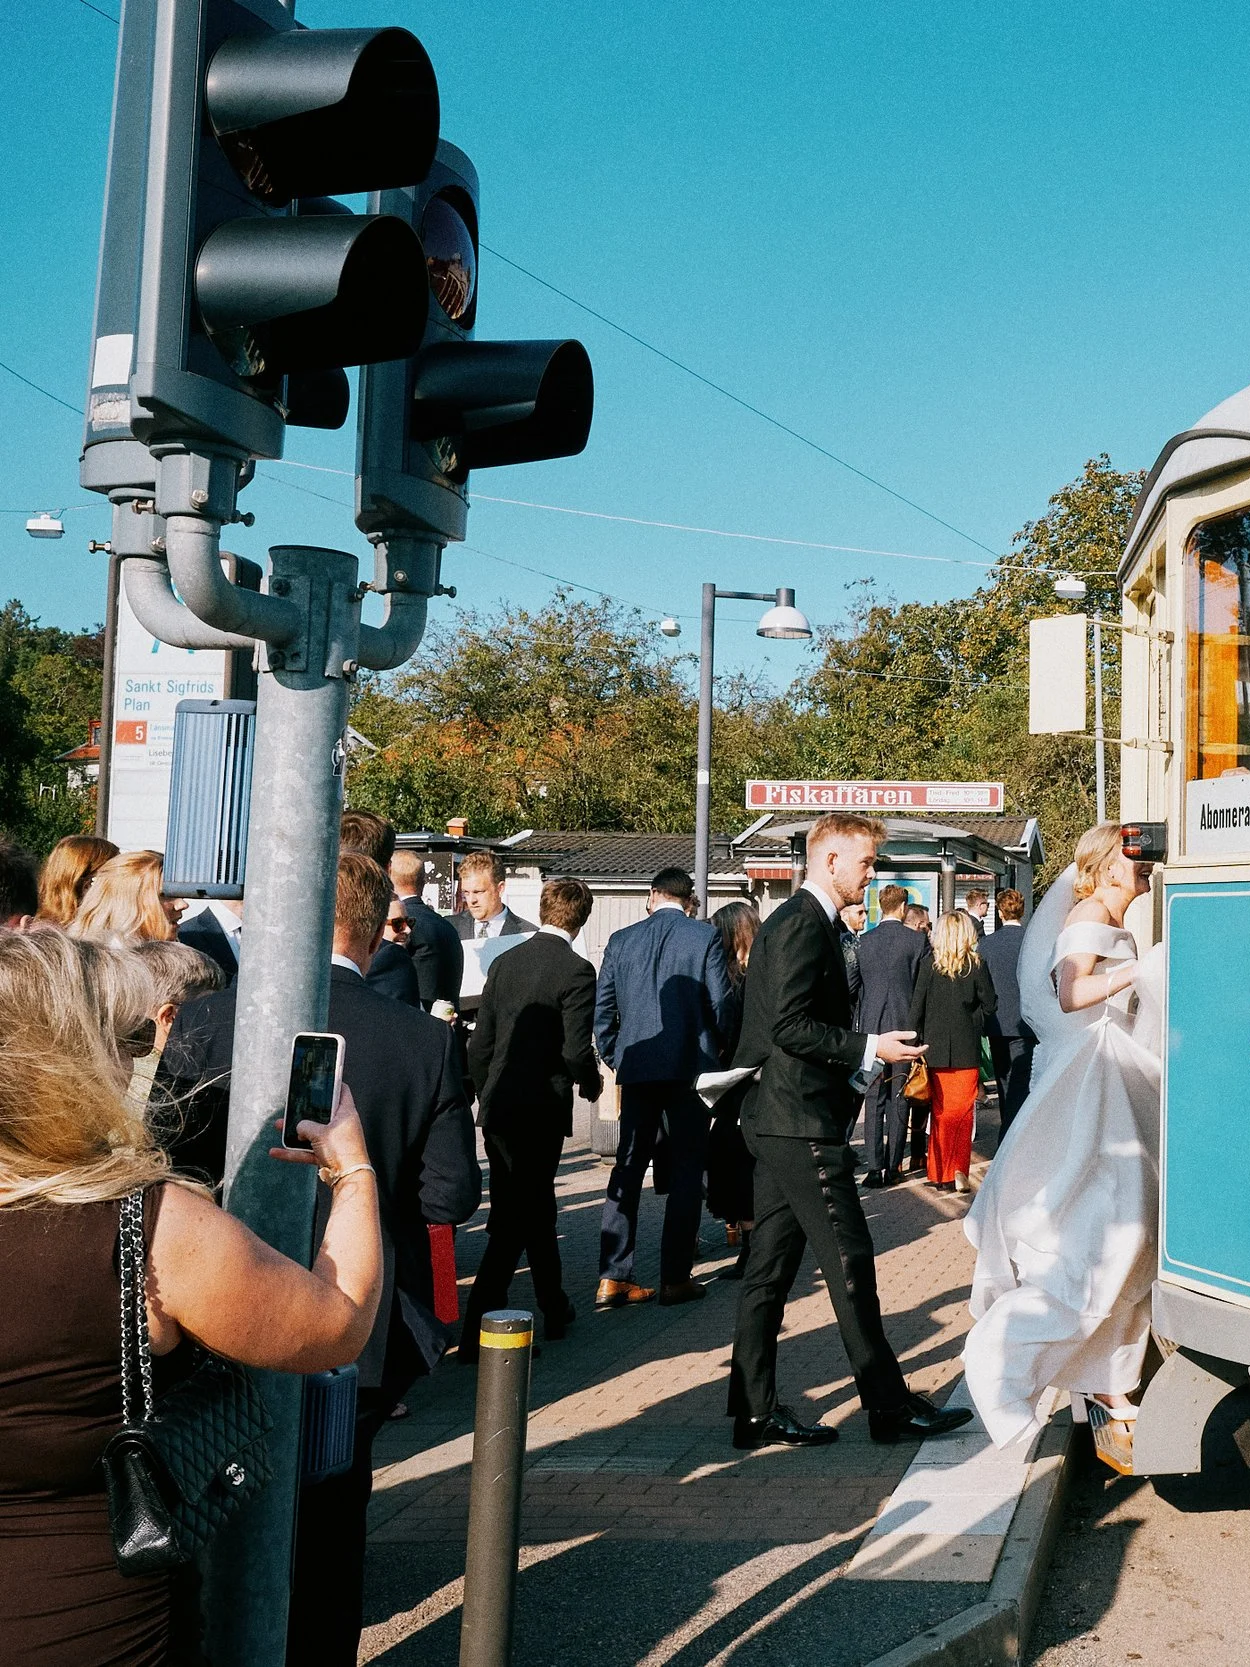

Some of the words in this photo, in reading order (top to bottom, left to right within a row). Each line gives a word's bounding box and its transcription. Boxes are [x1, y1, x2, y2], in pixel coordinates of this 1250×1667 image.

[125, 679, 161, 694] Sankt
[166, 679, 215, 696] Sigfrids
[124, 697, 151, 712] Plan
[135, 725, 144, 741] 5
[764, 785, 913, 805] Fiskaffären
